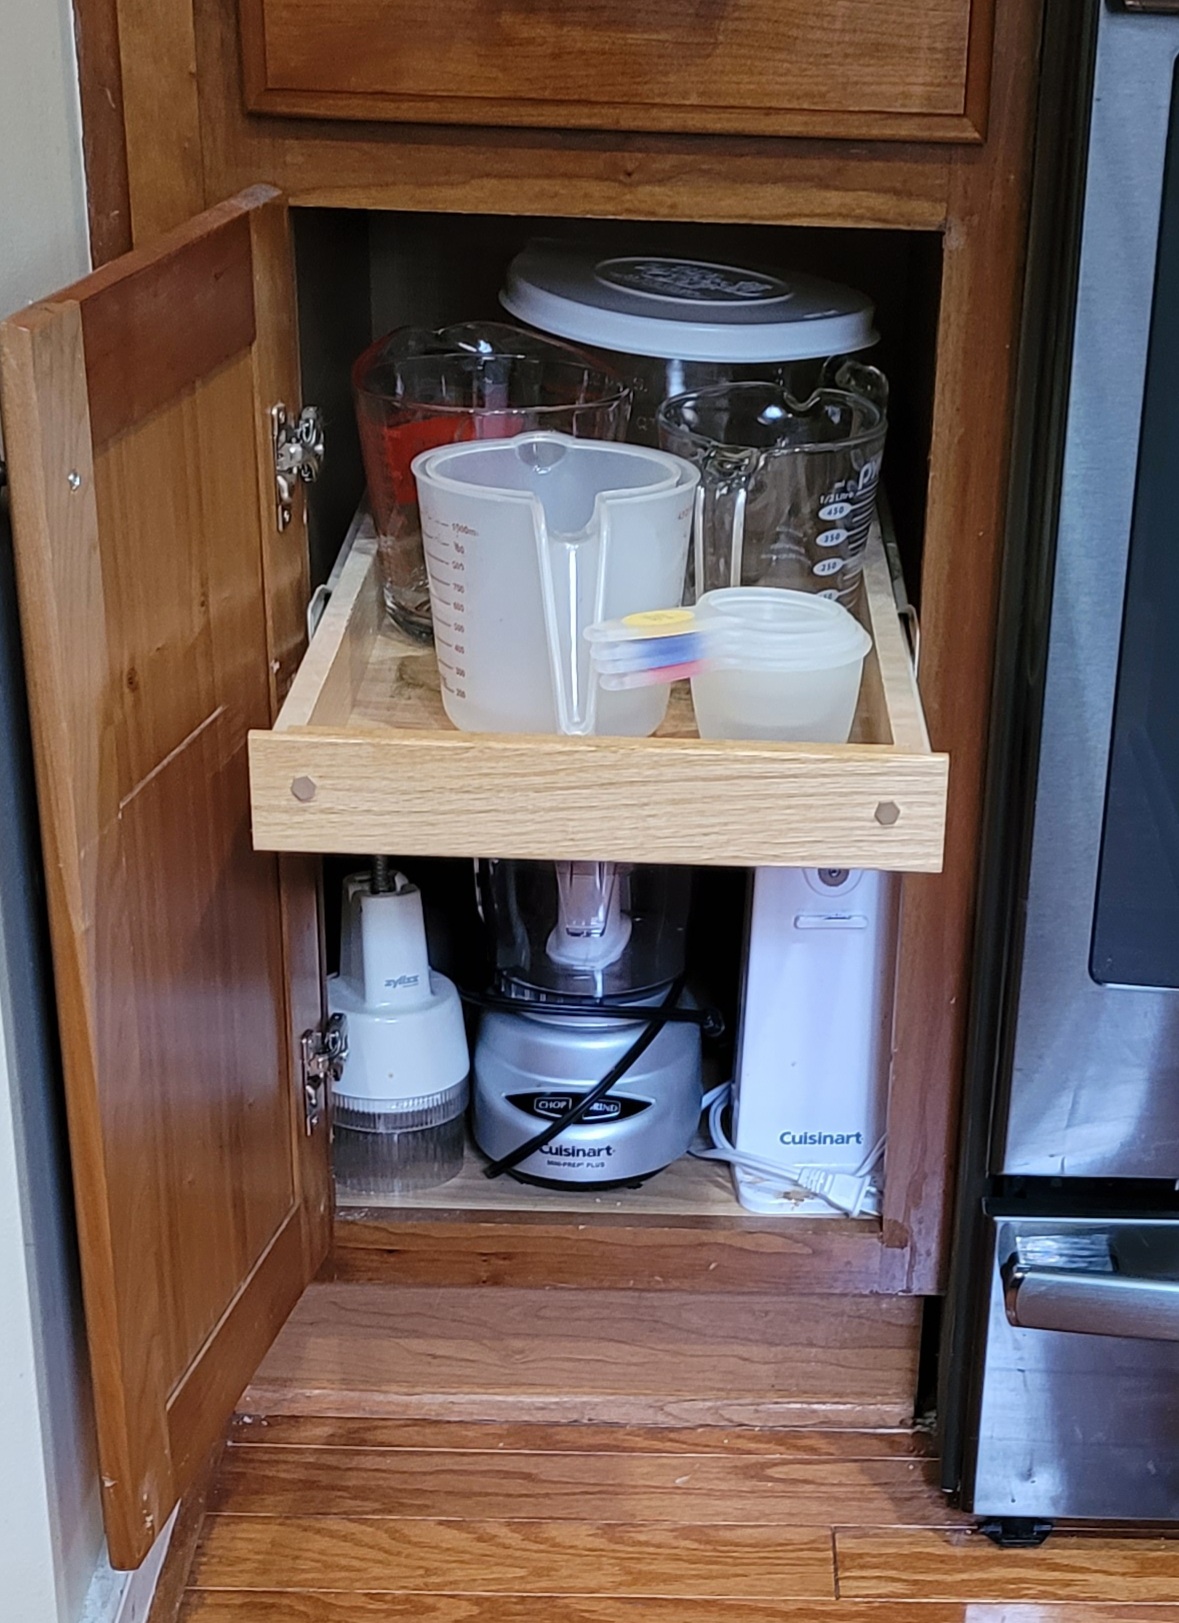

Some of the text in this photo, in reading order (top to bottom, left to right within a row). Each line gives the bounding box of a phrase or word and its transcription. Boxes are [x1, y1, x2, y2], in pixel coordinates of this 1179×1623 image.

[826, 505, 845, 517] 450
[823, 532, 841, 544] 350
[820, 561, 838, 573] 250
[538, 1100, 567, 1109] CHOP
[779, 1131, 863, 1146] Cuisinart
[537, 1143, 613, 1158] Cuisinart
